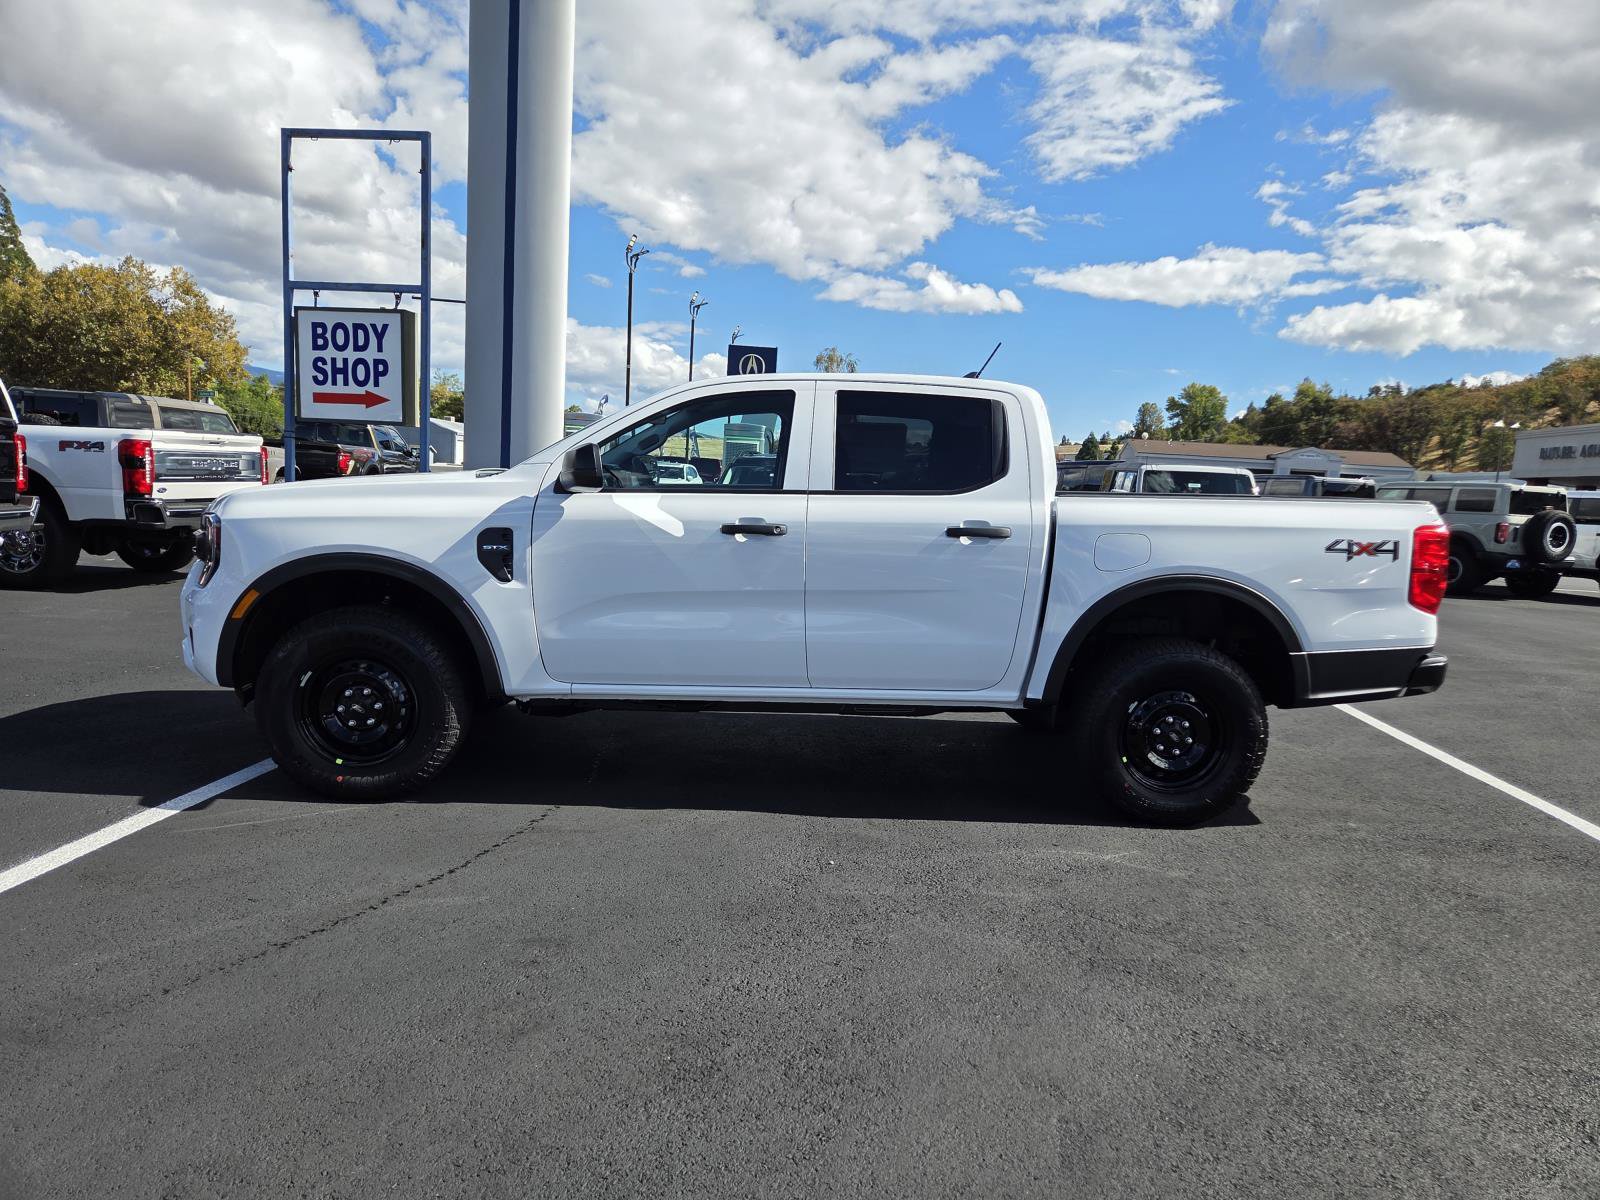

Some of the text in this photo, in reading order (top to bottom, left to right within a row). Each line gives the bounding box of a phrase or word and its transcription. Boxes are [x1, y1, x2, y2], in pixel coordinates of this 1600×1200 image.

[311, 321, 389, 353] BODY
[312, 356, 389, 388] SHOP
[59, 440, 104, 451] FX4
